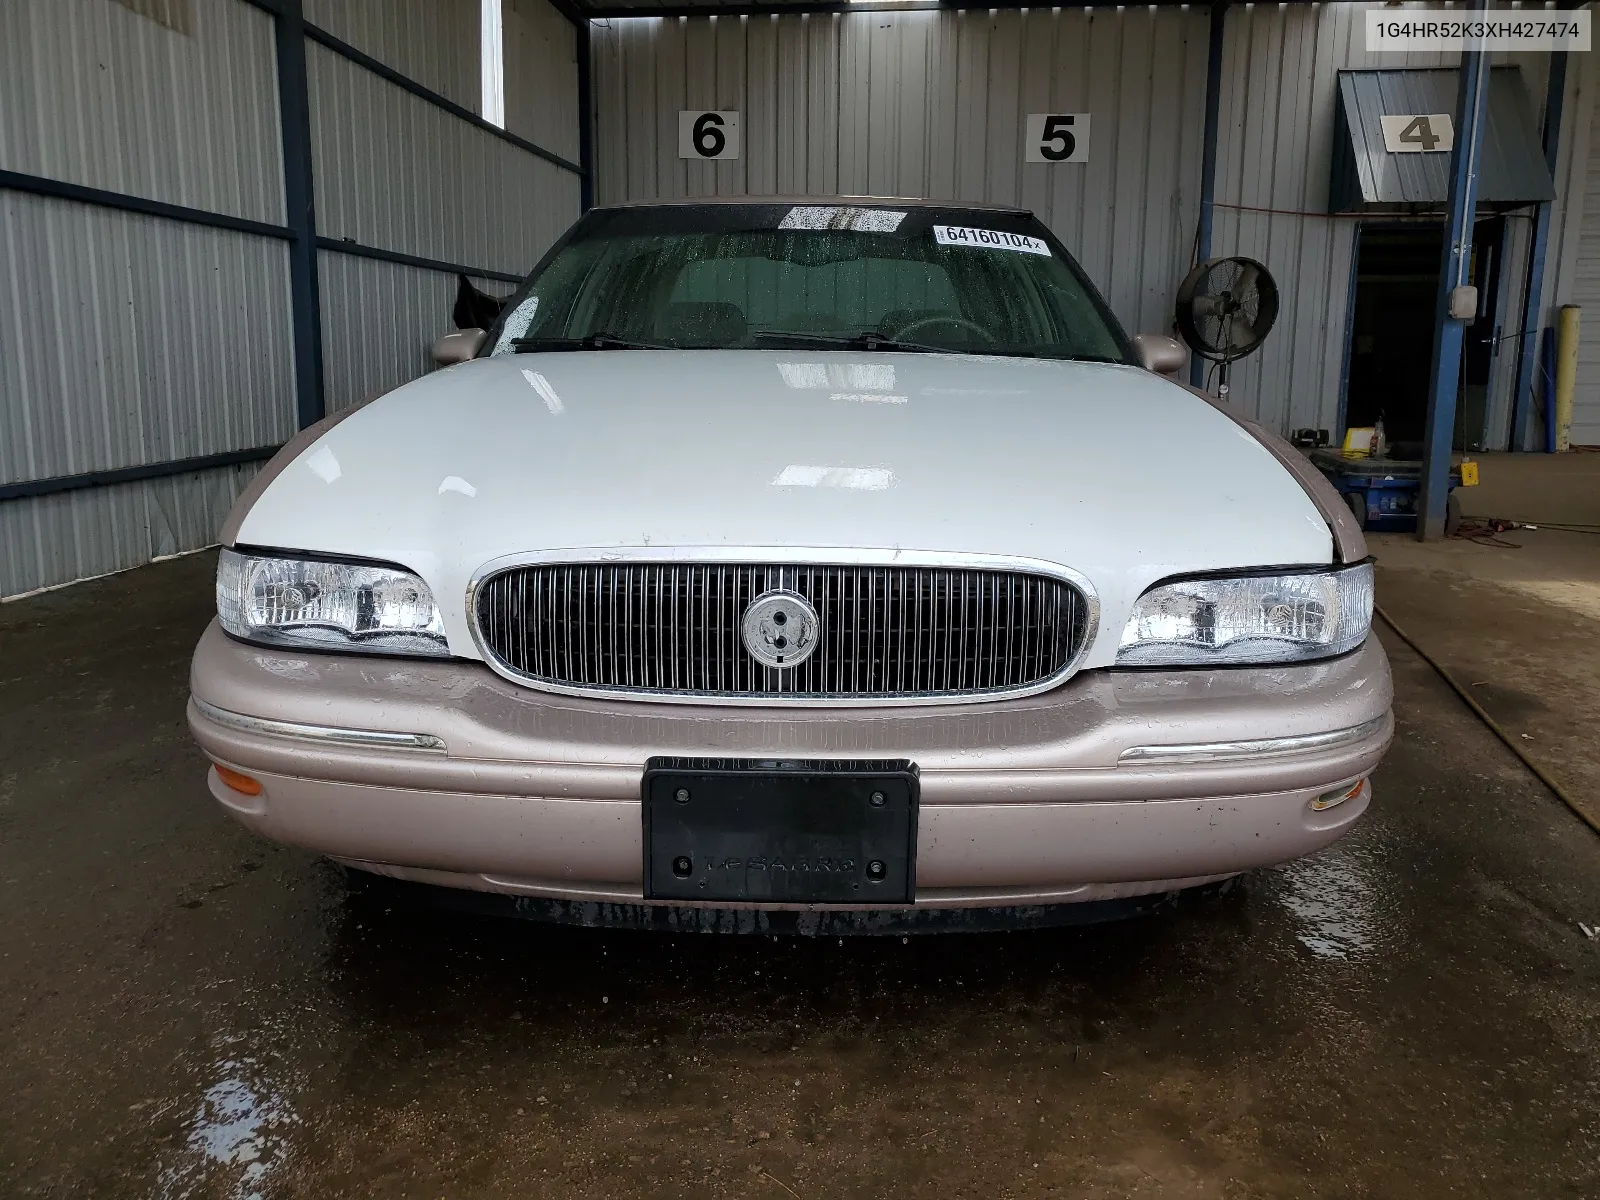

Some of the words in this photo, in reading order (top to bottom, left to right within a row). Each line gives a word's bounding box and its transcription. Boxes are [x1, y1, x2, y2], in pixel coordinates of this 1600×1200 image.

[692, 112, 726, 158] 6
[1039, 115, 1076, 161] 5
[1399, 116, 1441, 150] 4
